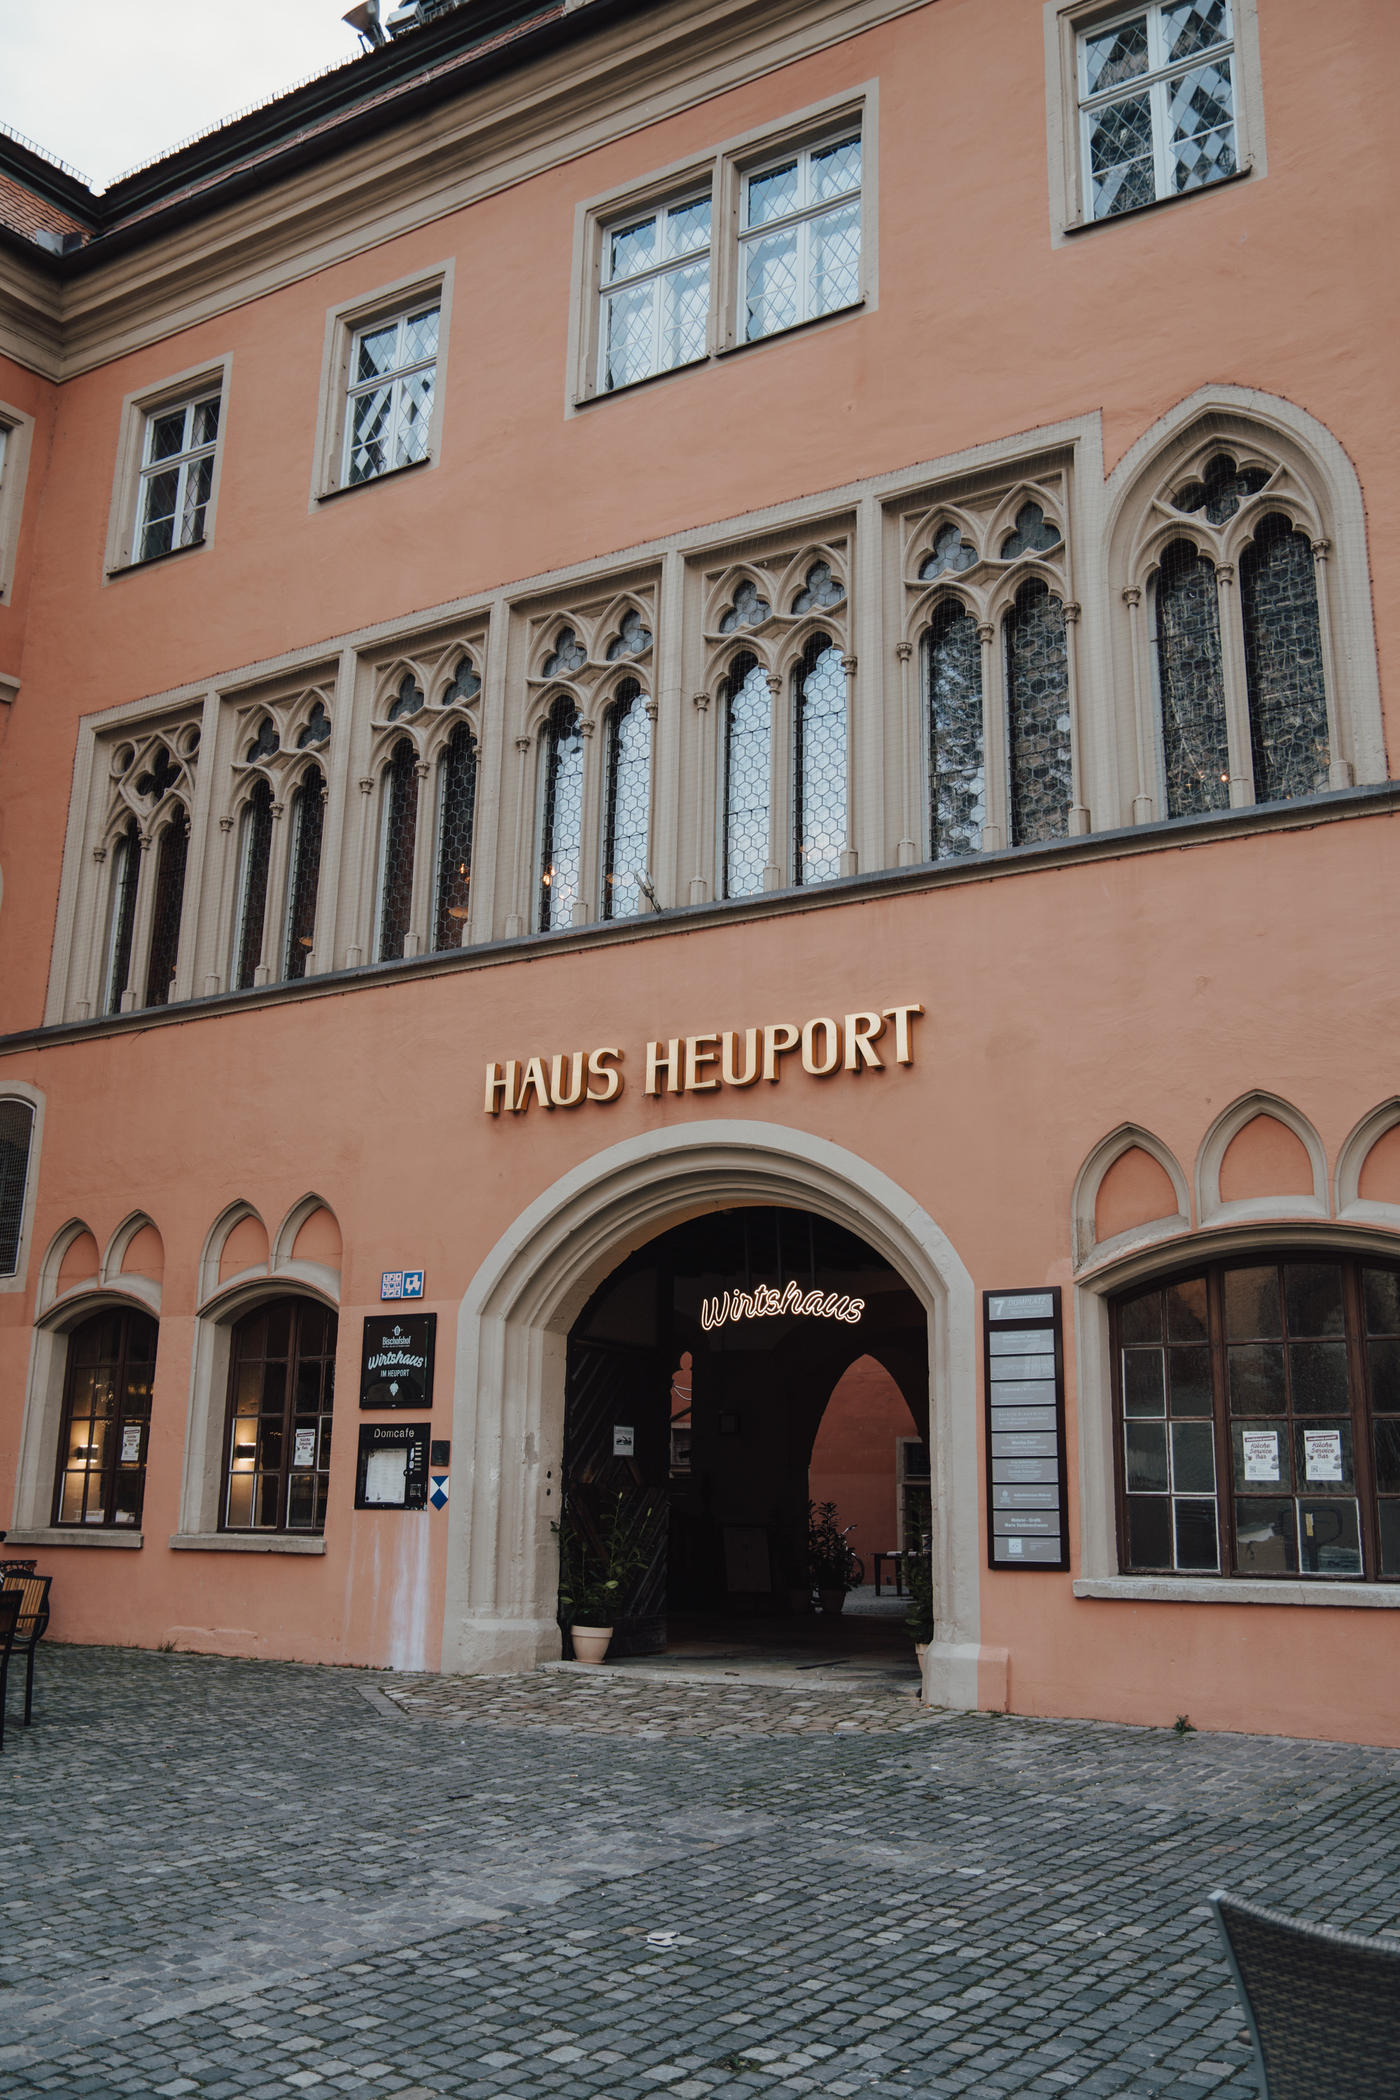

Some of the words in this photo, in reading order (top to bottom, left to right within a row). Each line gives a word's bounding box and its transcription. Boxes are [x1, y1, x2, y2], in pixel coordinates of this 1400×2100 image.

[484, 1047, 626, 1116] HAUS
[644, 1003, 927, 1096] HEUPORT
[702, 1280, 865, 1330] Wirtshaus
[994, 1300, 1005, 1316] 7
[368, 1350, 424, 1370] Wirtshaus
[388, 1369, 410, 1377] HEUPORT
